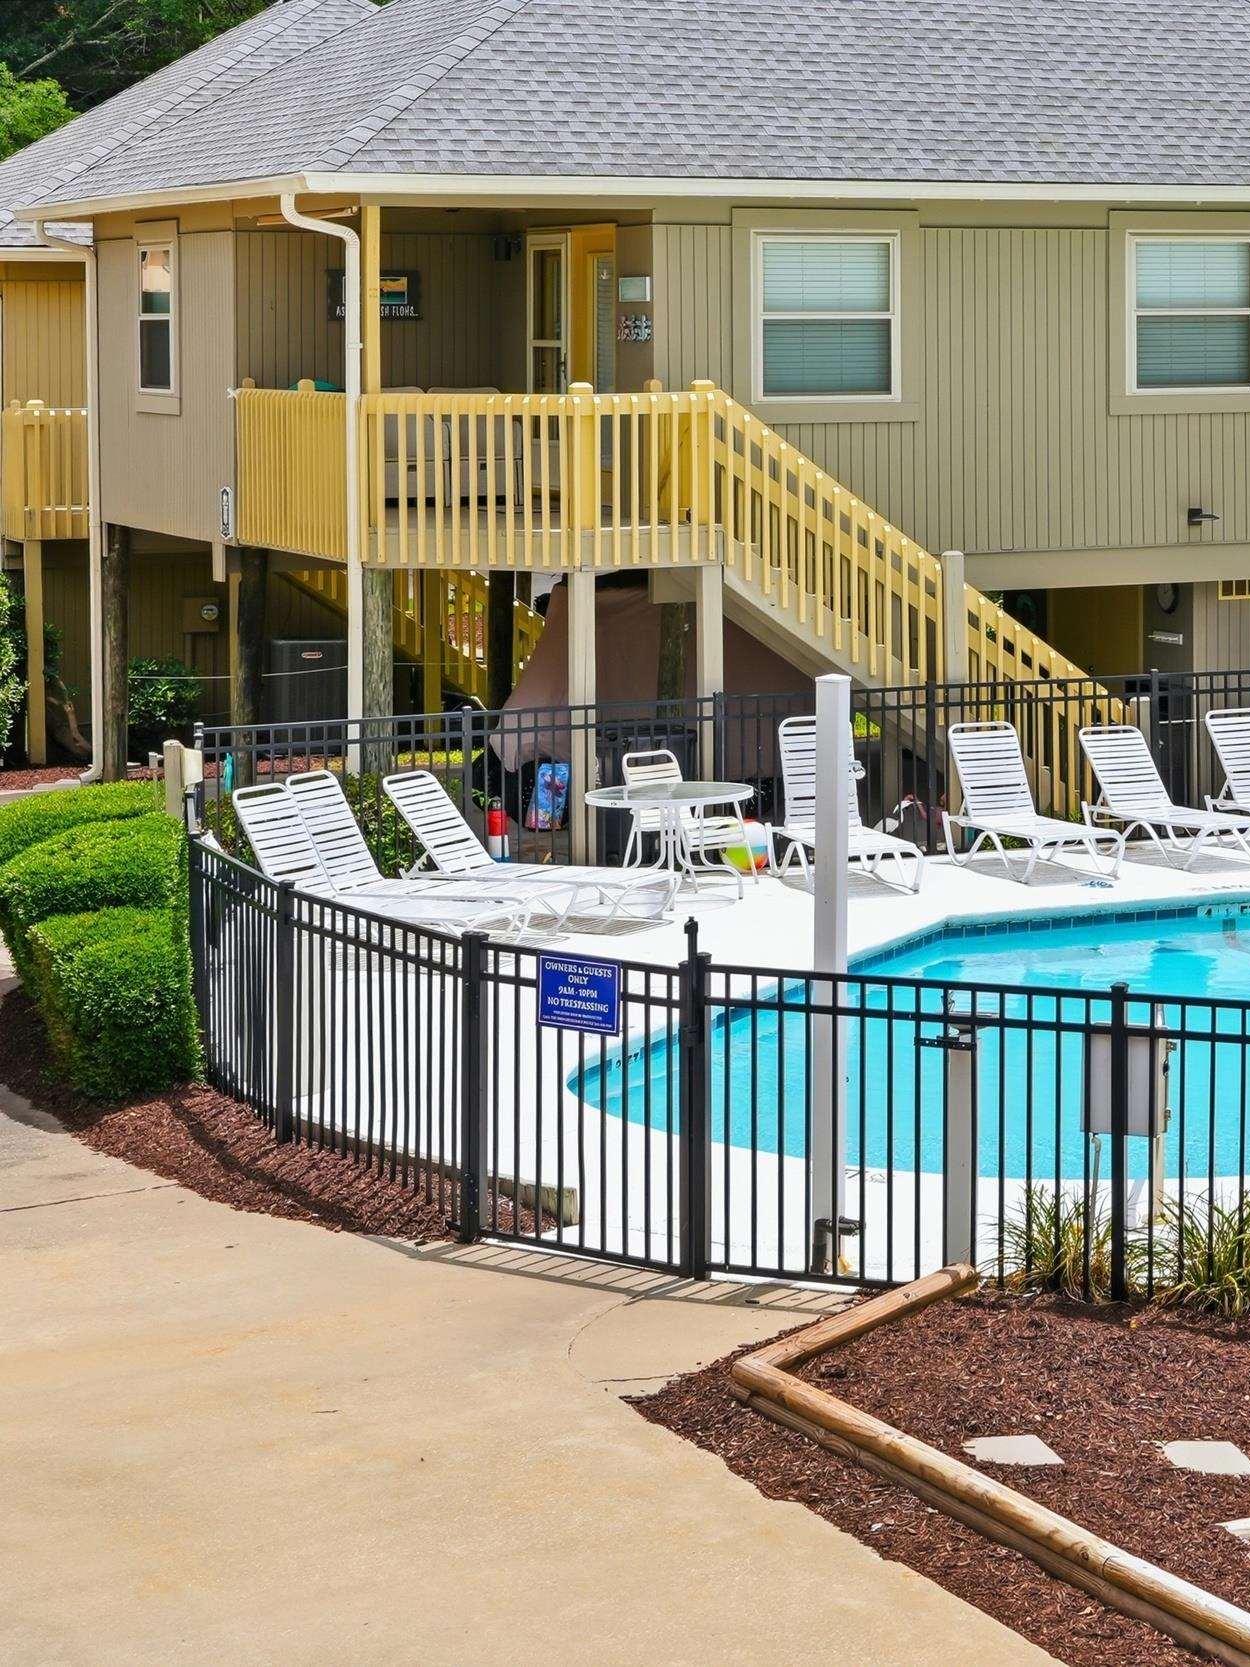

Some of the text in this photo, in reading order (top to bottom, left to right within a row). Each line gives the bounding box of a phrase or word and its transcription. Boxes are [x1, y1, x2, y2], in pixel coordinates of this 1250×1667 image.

[545, 961, 577, 974] OWNERS
[583, 966, 612, 978] GUESTS
[568, 975, 589, 985] ONLY
[558, 986, 574, 995] 9AM
[579, 989, 598, 998] 10PM
[547, 997, 609, 1013] NO TRESPASSING
